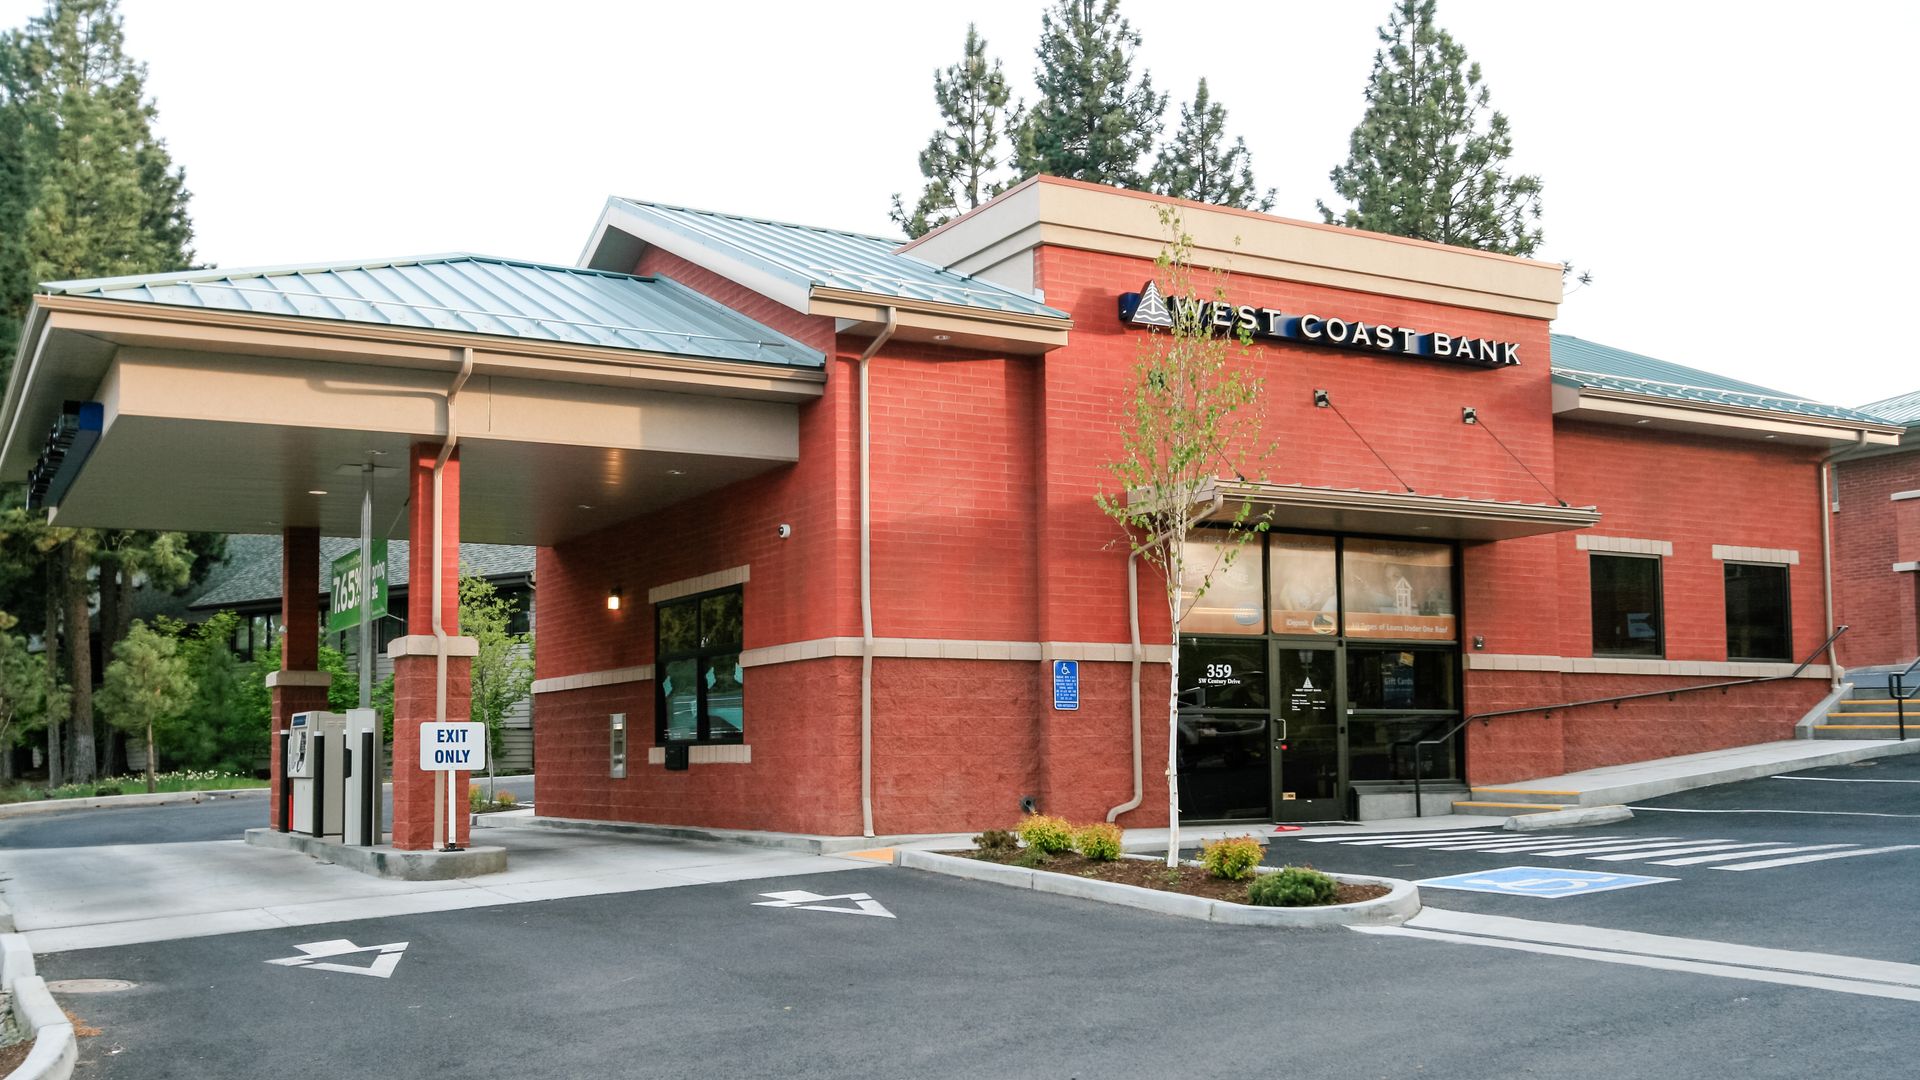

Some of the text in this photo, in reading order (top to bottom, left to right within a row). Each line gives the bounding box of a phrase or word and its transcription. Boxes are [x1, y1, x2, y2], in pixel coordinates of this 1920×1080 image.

[1173, 295, 1522, 365] WEST COAST BANK
[1206, 663, 1232, 678] 359
[437, 729, 468, 743] EXIT
[434, 749, 471, 764] ONLY
